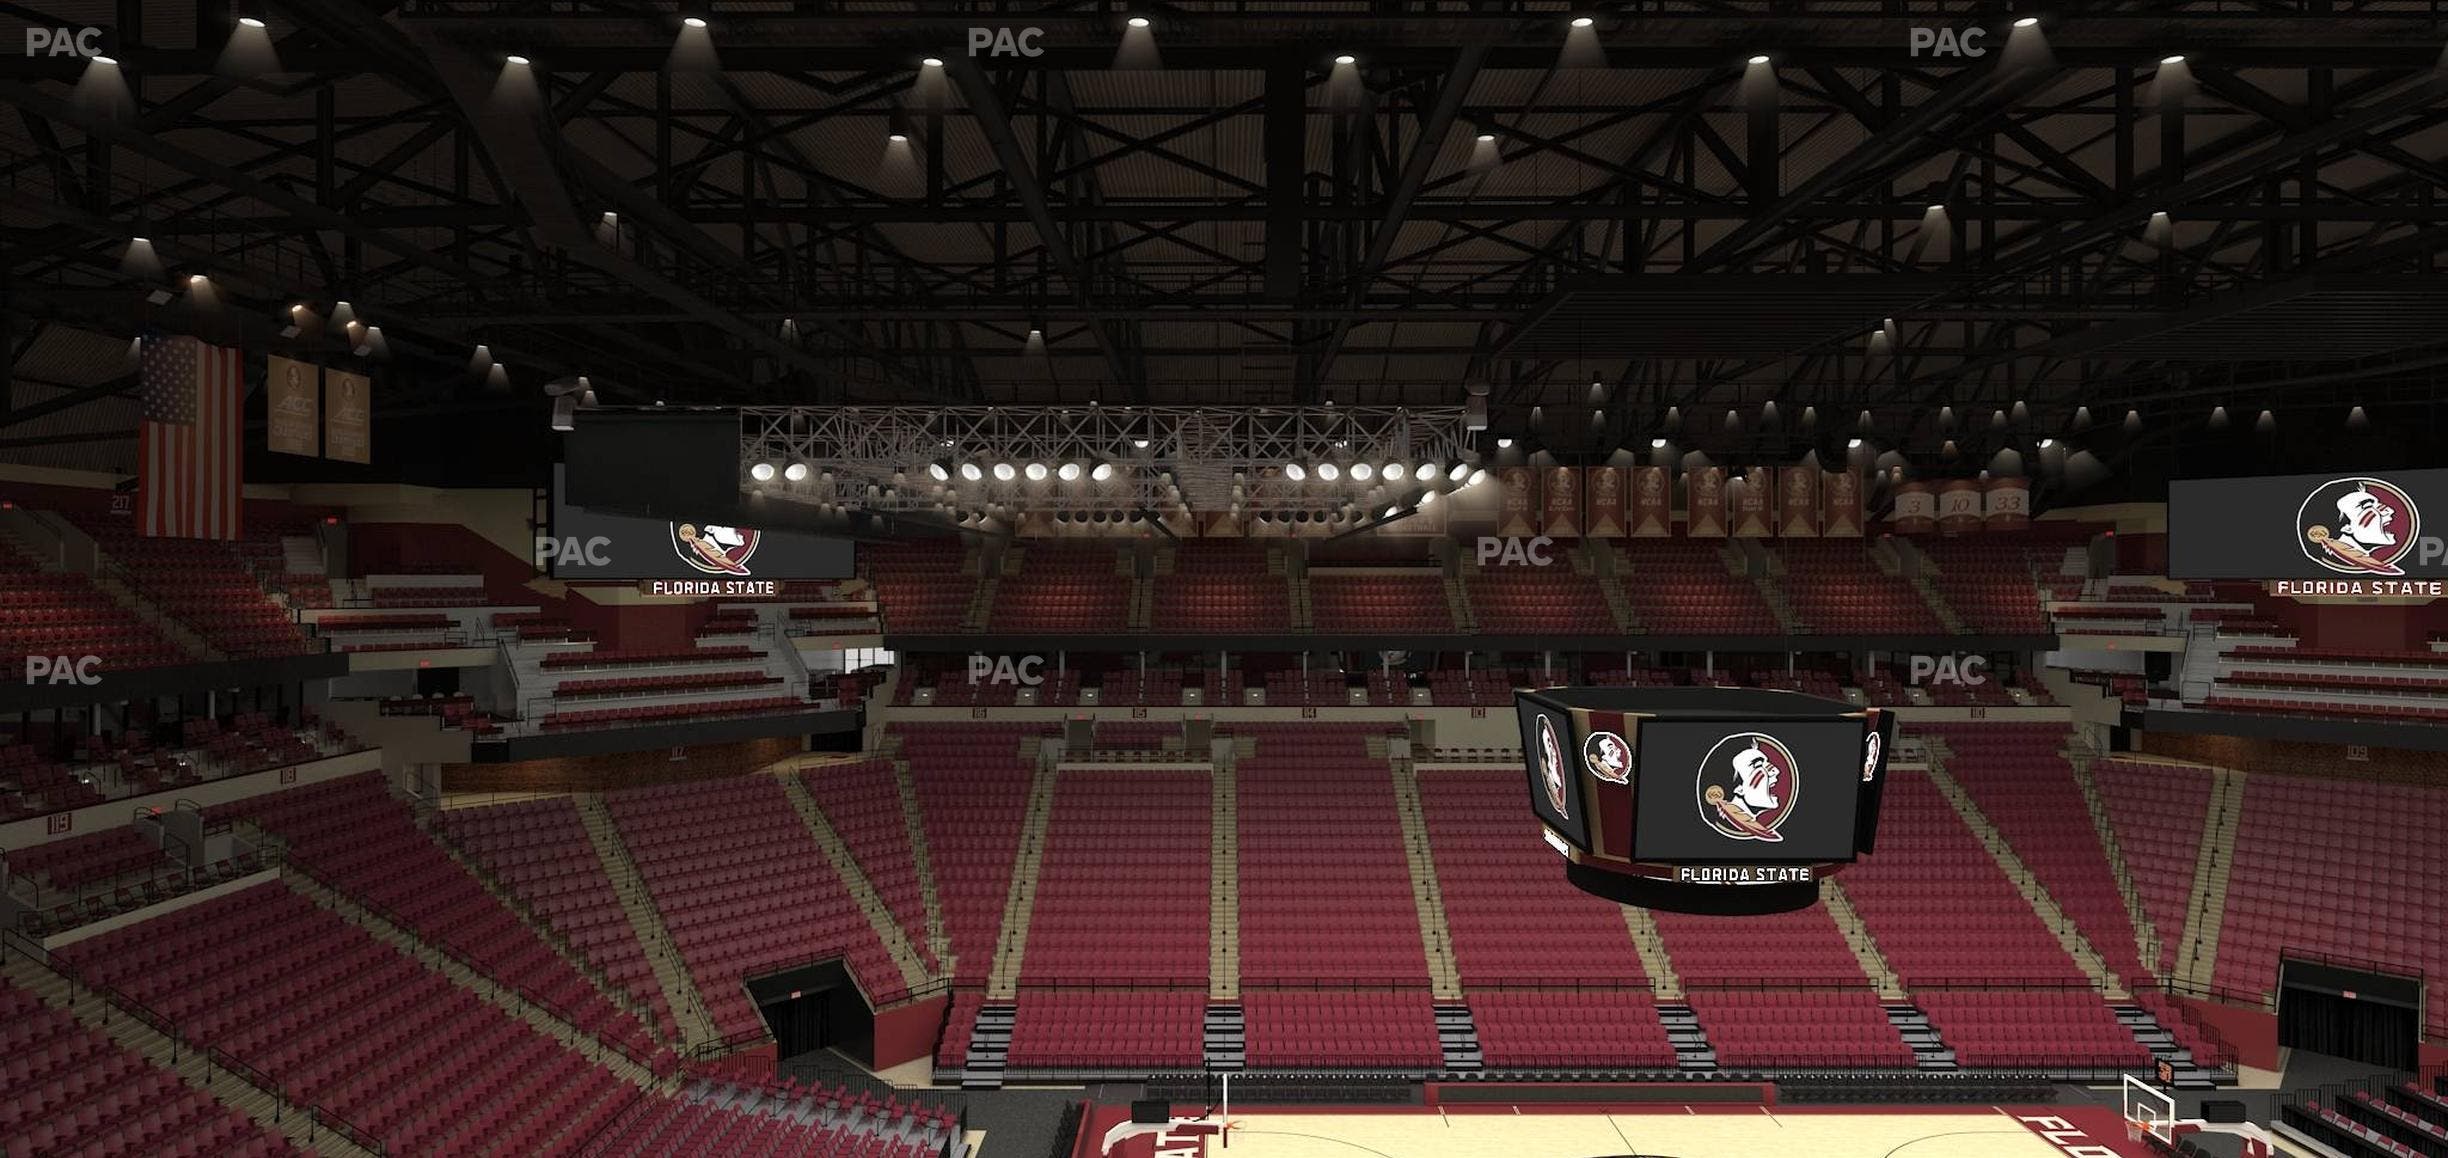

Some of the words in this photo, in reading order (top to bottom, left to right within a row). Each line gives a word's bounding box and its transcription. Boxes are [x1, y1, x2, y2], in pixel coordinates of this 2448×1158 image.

[112, 495, 130, 509] 217
[1908, 497, 1920, 513] 3
[1951, 498, 1969, 513] 10
[1995, 496, 2020, 511] 33
[653, 581, 720, 595] FLORIDA
[726, 581, 775, 595] STATE
[2277, 580, 2363, 596] FLORIDA
[2372, 580, 2442, 596] STATE
[2347, 745, 2368, 757] 109
[1681, 867, 1750, 881] FLORIDA
[1756, 867, 1810, 881] STATE
